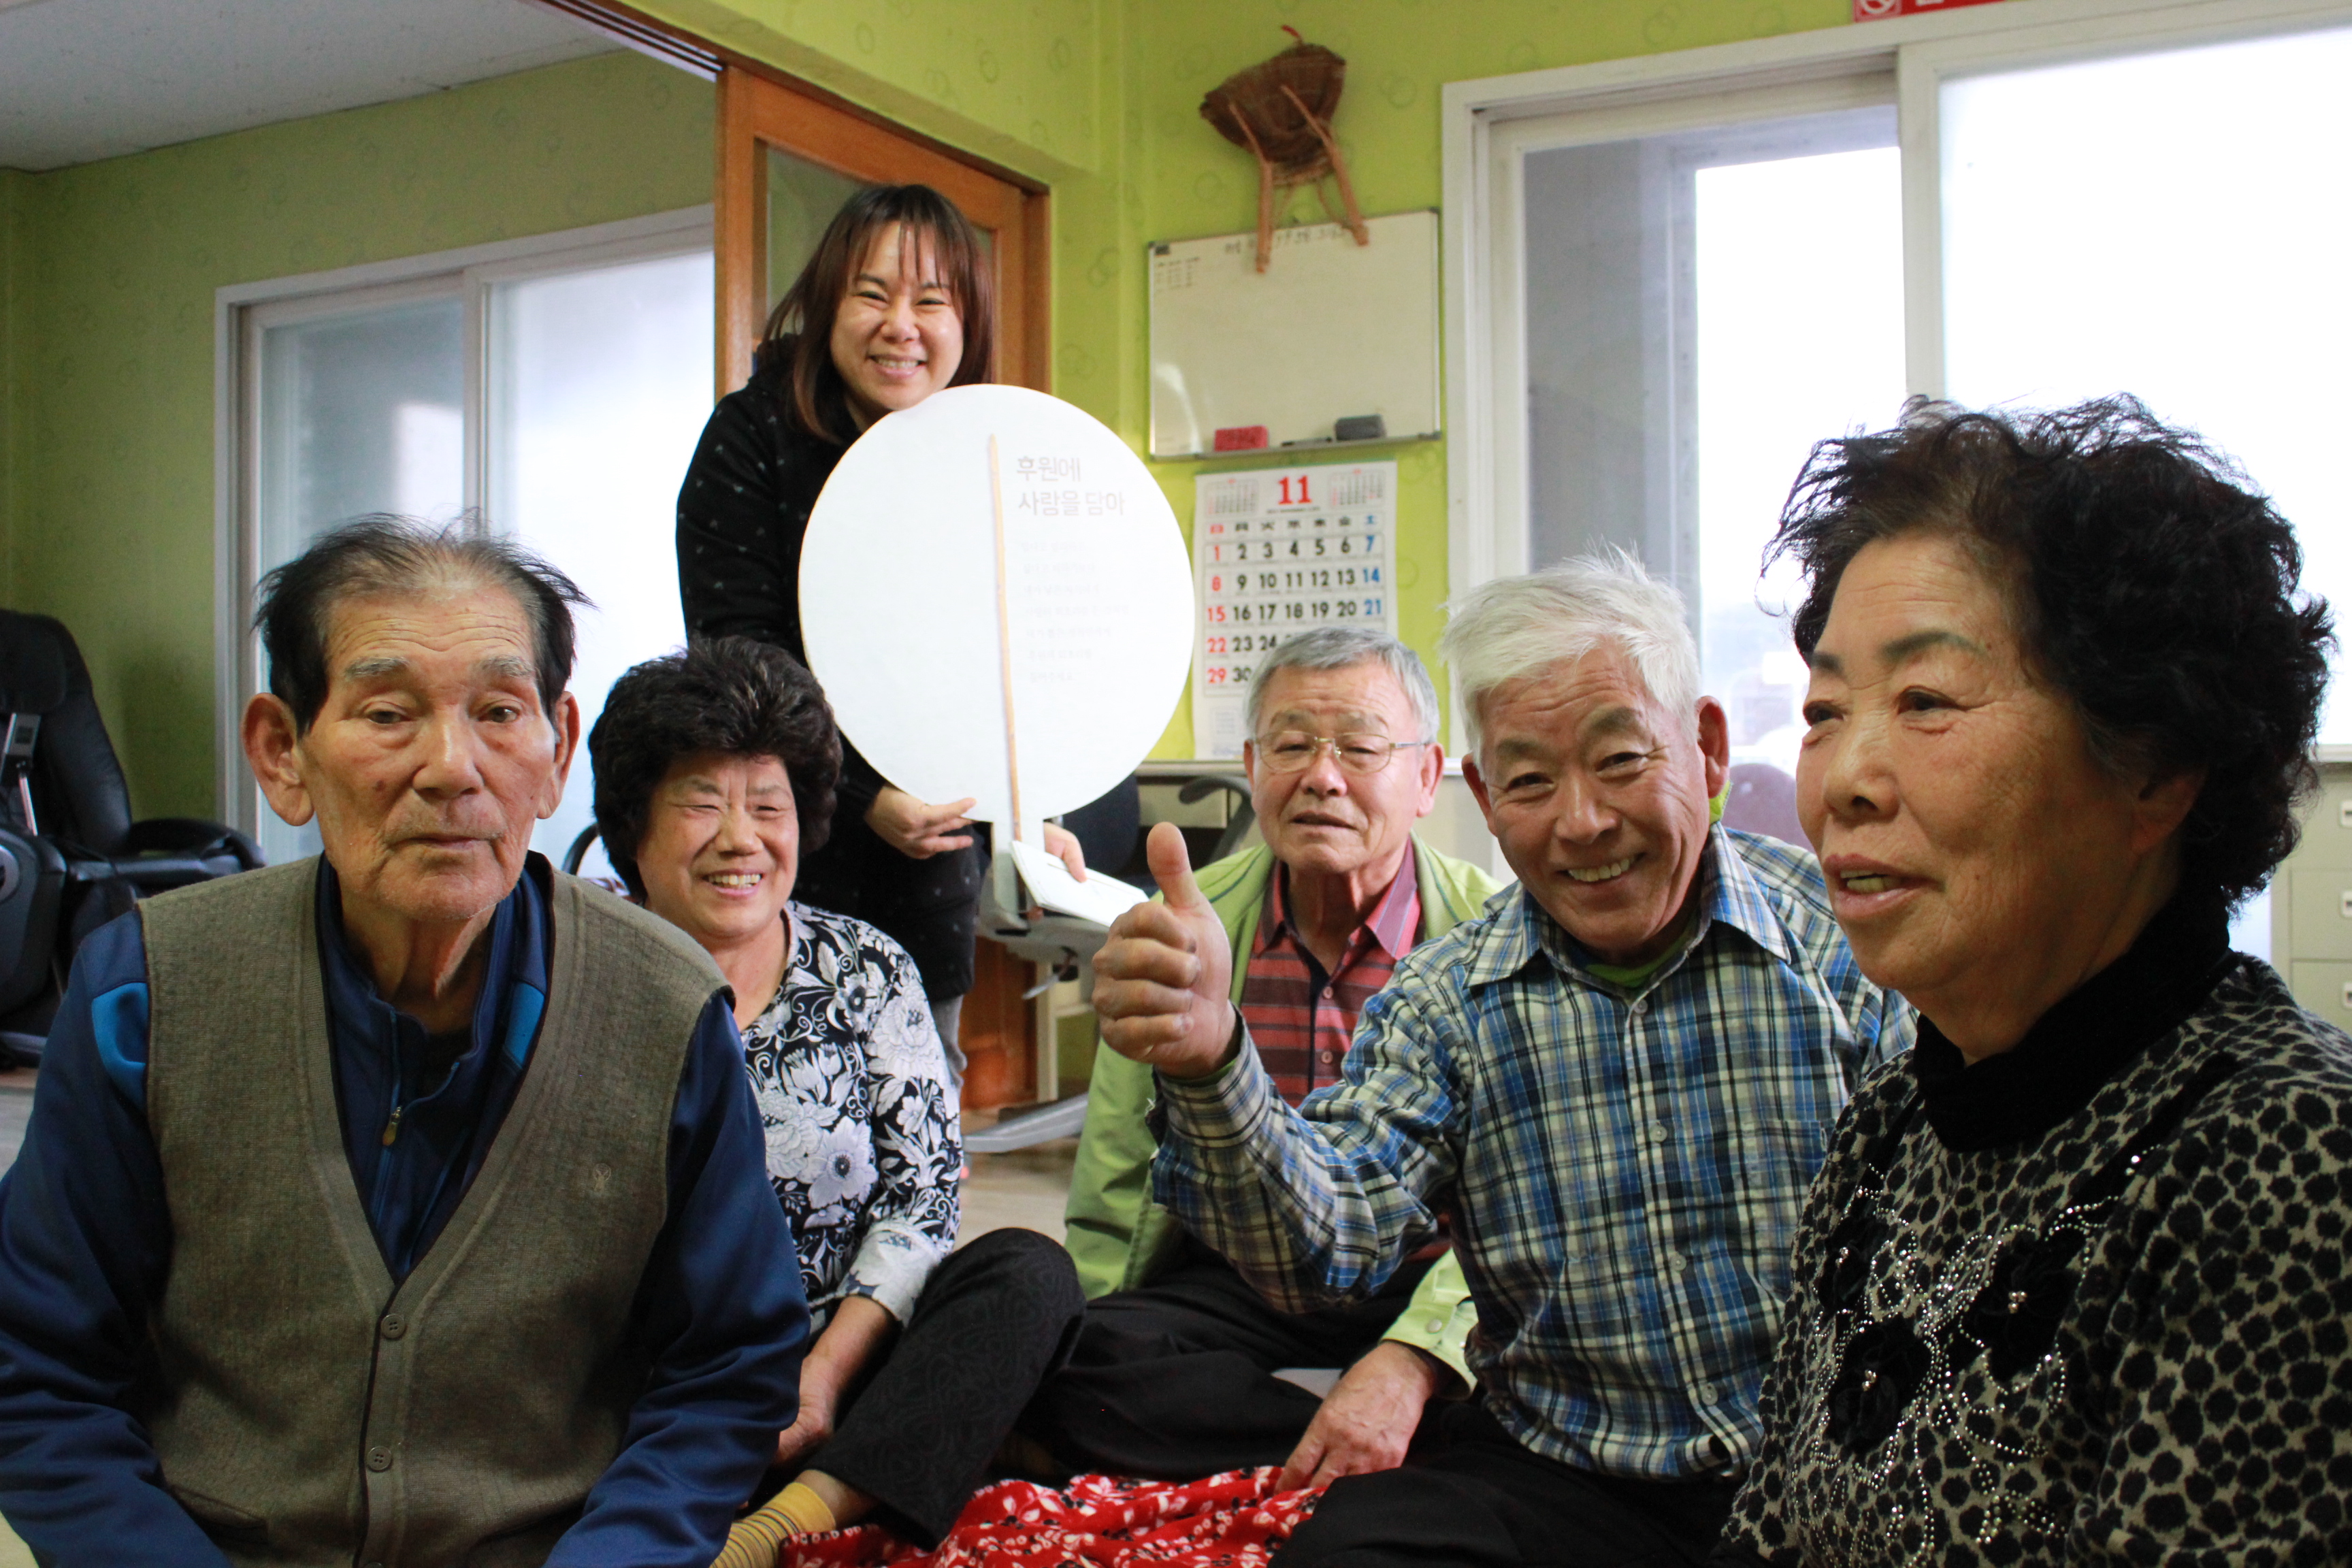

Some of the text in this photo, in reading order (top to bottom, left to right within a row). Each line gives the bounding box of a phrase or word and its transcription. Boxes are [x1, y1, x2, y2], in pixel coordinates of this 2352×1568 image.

[1017, 456, 1081, 482] 후원에
[1277, 474, 1312, 505] 11
[1085, 491, 1126, 516] 담아
[1214, 534, 1375, 561] 1 2 3 4 5 6 7
[1211, 567, 1380, 591] 8 9 10 11 12 13 14
[1207, 599, 1381, 622] 15 16 17 18 19 20 21
[1207, 634, 1277, 653] 22 23 24
[1207, 668, 1226, 683] 29
